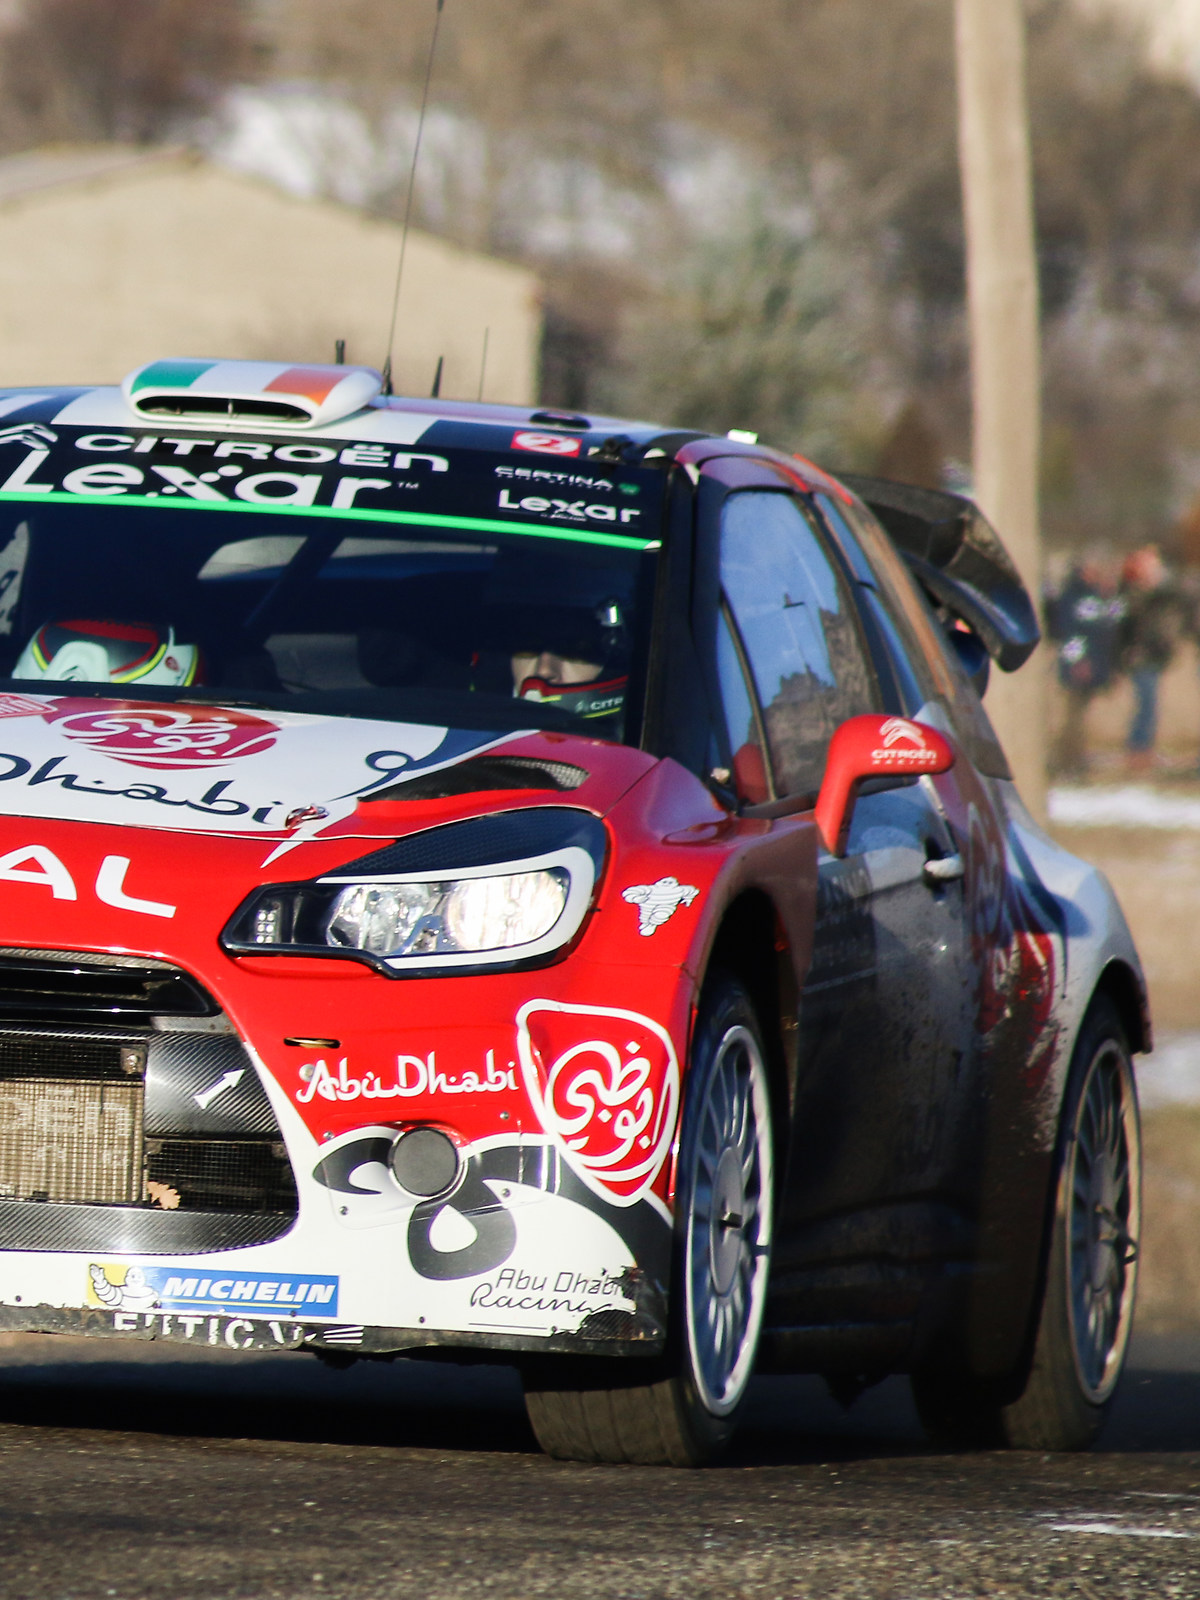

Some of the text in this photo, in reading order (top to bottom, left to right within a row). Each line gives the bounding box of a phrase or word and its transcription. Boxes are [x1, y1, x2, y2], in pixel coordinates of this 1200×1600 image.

[0, 448, 393, 509] Lexar
[494, 465, 614, 491] CERTINA
[498, 488, 641, 523] Lexar
[396, 1049, 519, 1097] Dhabi
[161, 1277, 336, 1304] MICHELIN
[495, 1268, 548, 1291] Abu
